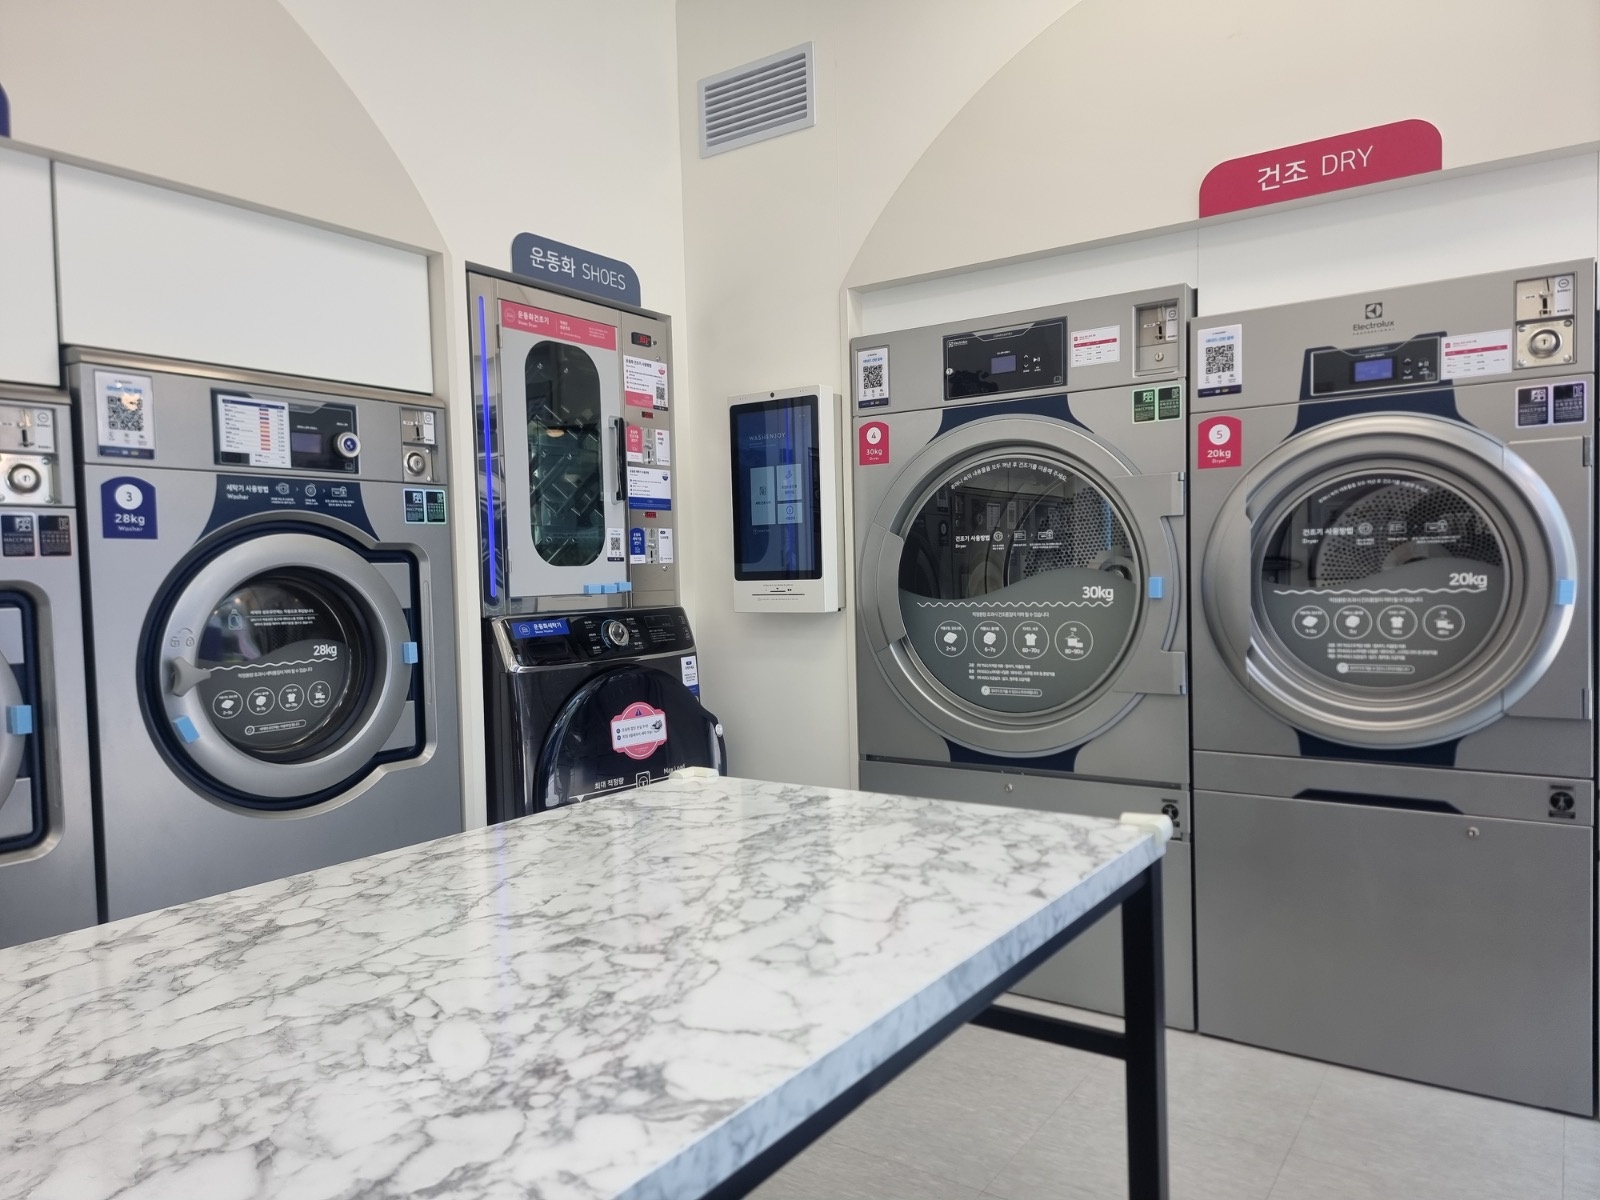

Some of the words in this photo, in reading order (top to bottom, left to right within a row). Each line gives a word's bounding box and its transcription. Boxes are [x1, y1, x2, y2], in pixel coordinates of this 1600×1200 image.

[1257, 160, 1309, 192] 건조
[1321, 144, 1374, 177] DRY
[530, 246, 576, 278] 운동화
[582, 263, 626, 291] SHOES
[1352, 320, 1395, 332] Electrolux
[748, 432, 786, 442] WASHENJOY
[871, 431, 877, 440] 4
[1216, 429, 1223, 439] 5
[865, 447, 883, 456] 30kg
[1207, 448, 1232, 459] 20kg
[991, 463, 1001, 471] 모두
[1018, 462, 1038, 471] 건조기를
[1038, 465, 1053, 475] 이용해
[226, 483, 245, 493] 세탁기
[245, 484, 270, 494] 사용방법
[126, 492, 133, 502] 3
[226, 493, 250, 501] Washer
[114, 514, 146, 528] 28kg
[1302, 528, 1323, 536] 건조기
[1324, 526, 1354, 536] 사용방법
[955, 534, 970, 542] 건조기
[970, 534, 990, 542] 사용방법
[1448, 572, 1488, 588] 20kg
[1082, 585, 1114, 602] 30kg
[533, 622, 562, 631] 운동화세탁기
[313, 644, 338, 658] 28kg
[594, 780, 606, 790] 최대
